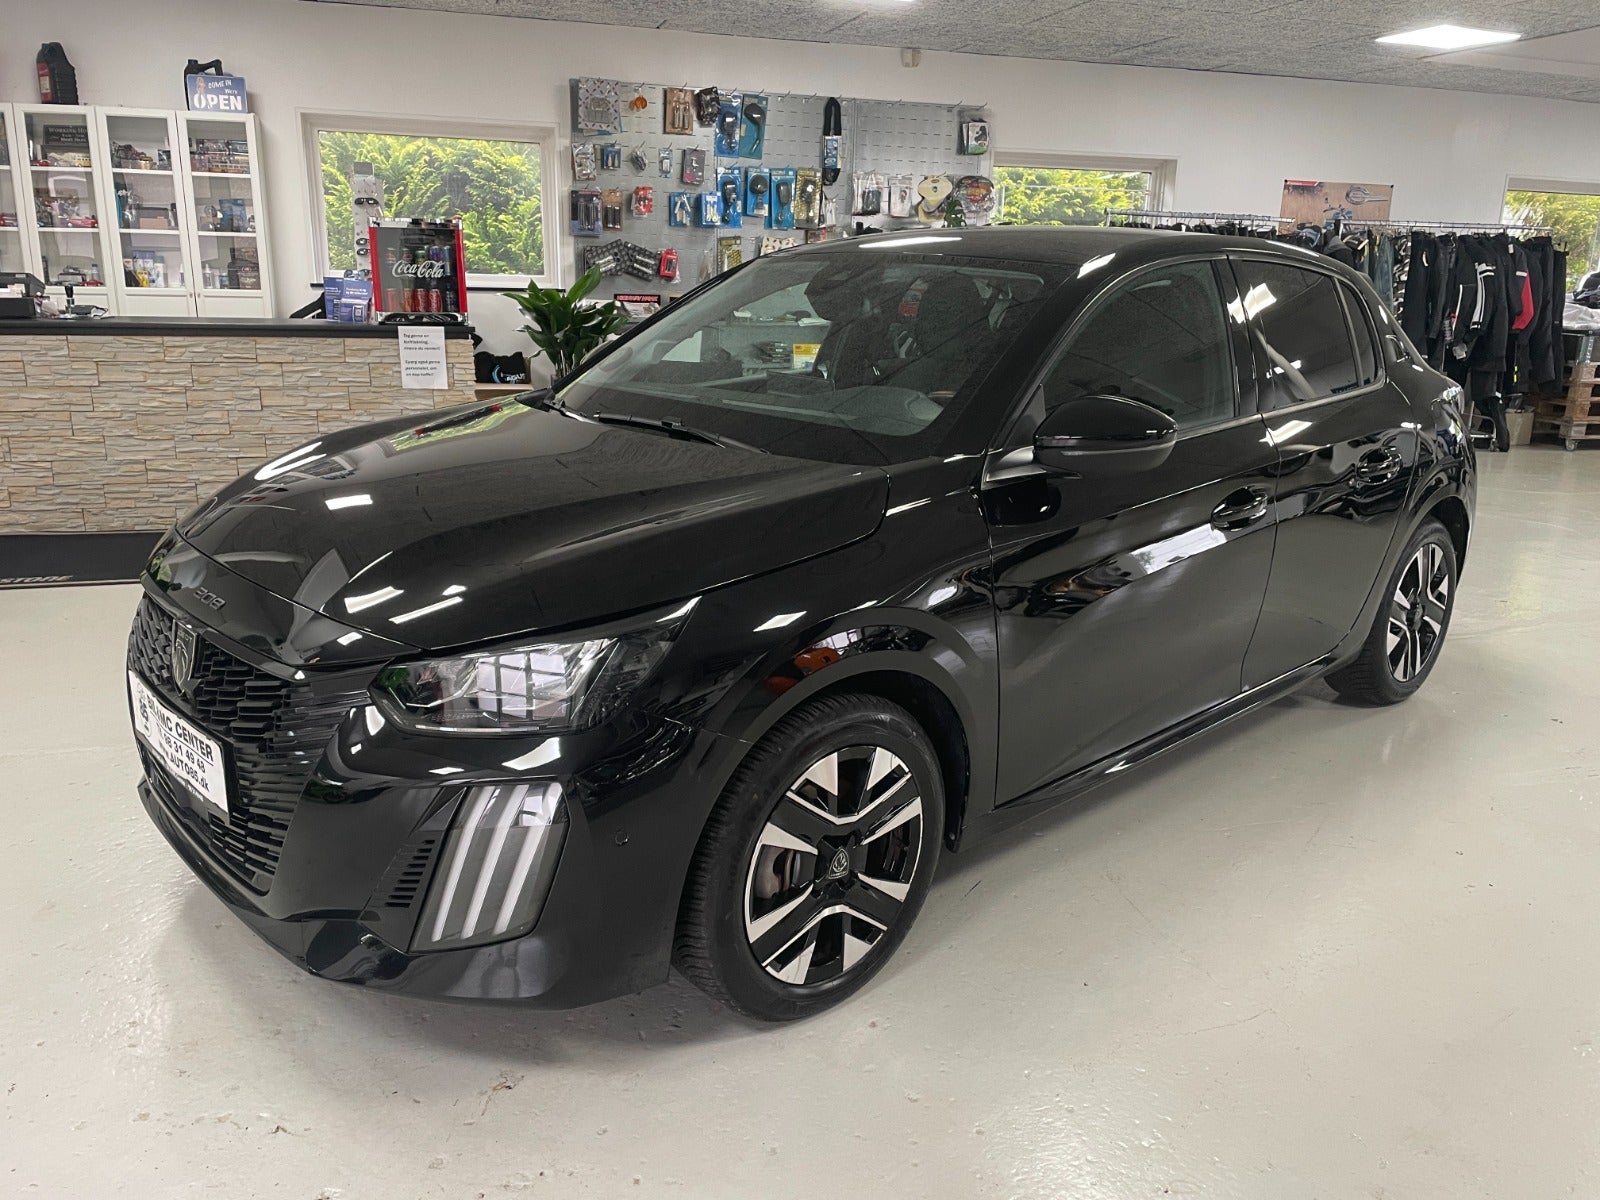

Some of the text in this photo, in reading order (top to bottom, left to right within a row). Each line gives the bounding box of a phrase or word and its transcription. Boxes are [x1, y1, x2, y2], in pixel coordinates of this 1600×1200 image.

[208, 79, 232, 89] COME IN
[193, 93, 243, 111] OPEN
[193, 586, 226, 610] 208
[174, 741, 183, 756] 31
[186, 750, 195, 764] 49
[175, 722, 214, 763] CENTER
